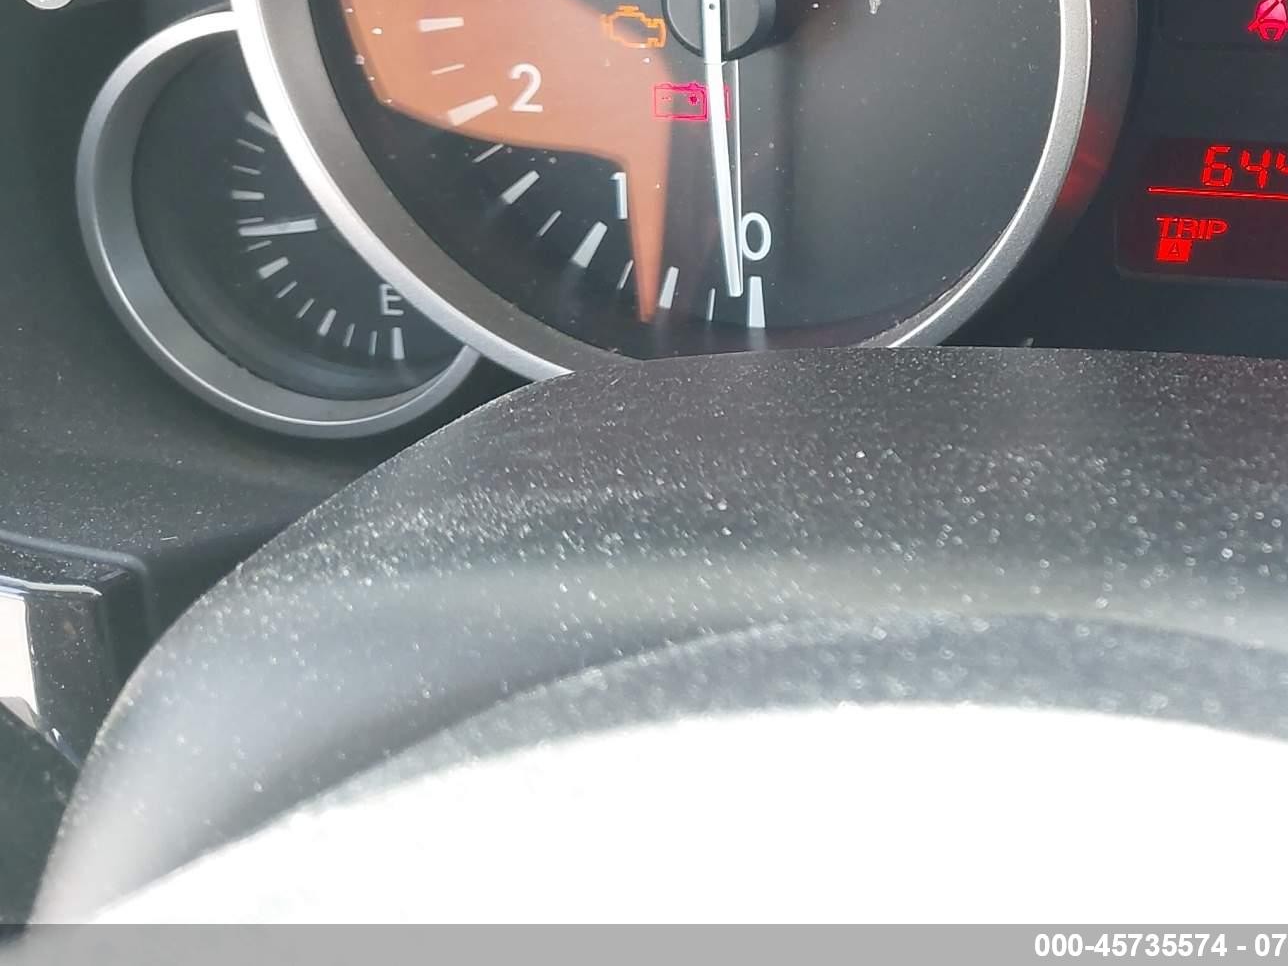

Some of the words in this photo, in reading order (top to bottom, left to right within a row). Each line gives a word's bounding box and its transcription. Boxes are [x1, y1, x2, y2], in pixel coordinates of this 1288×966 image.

[510, 63, 544, 113] 2
[610, 171, 628, 220] 1
[740, 211, 773, 262] 0
[1156, 217, 1228, 240] TRIP
[379, 283, 404, 316] E
